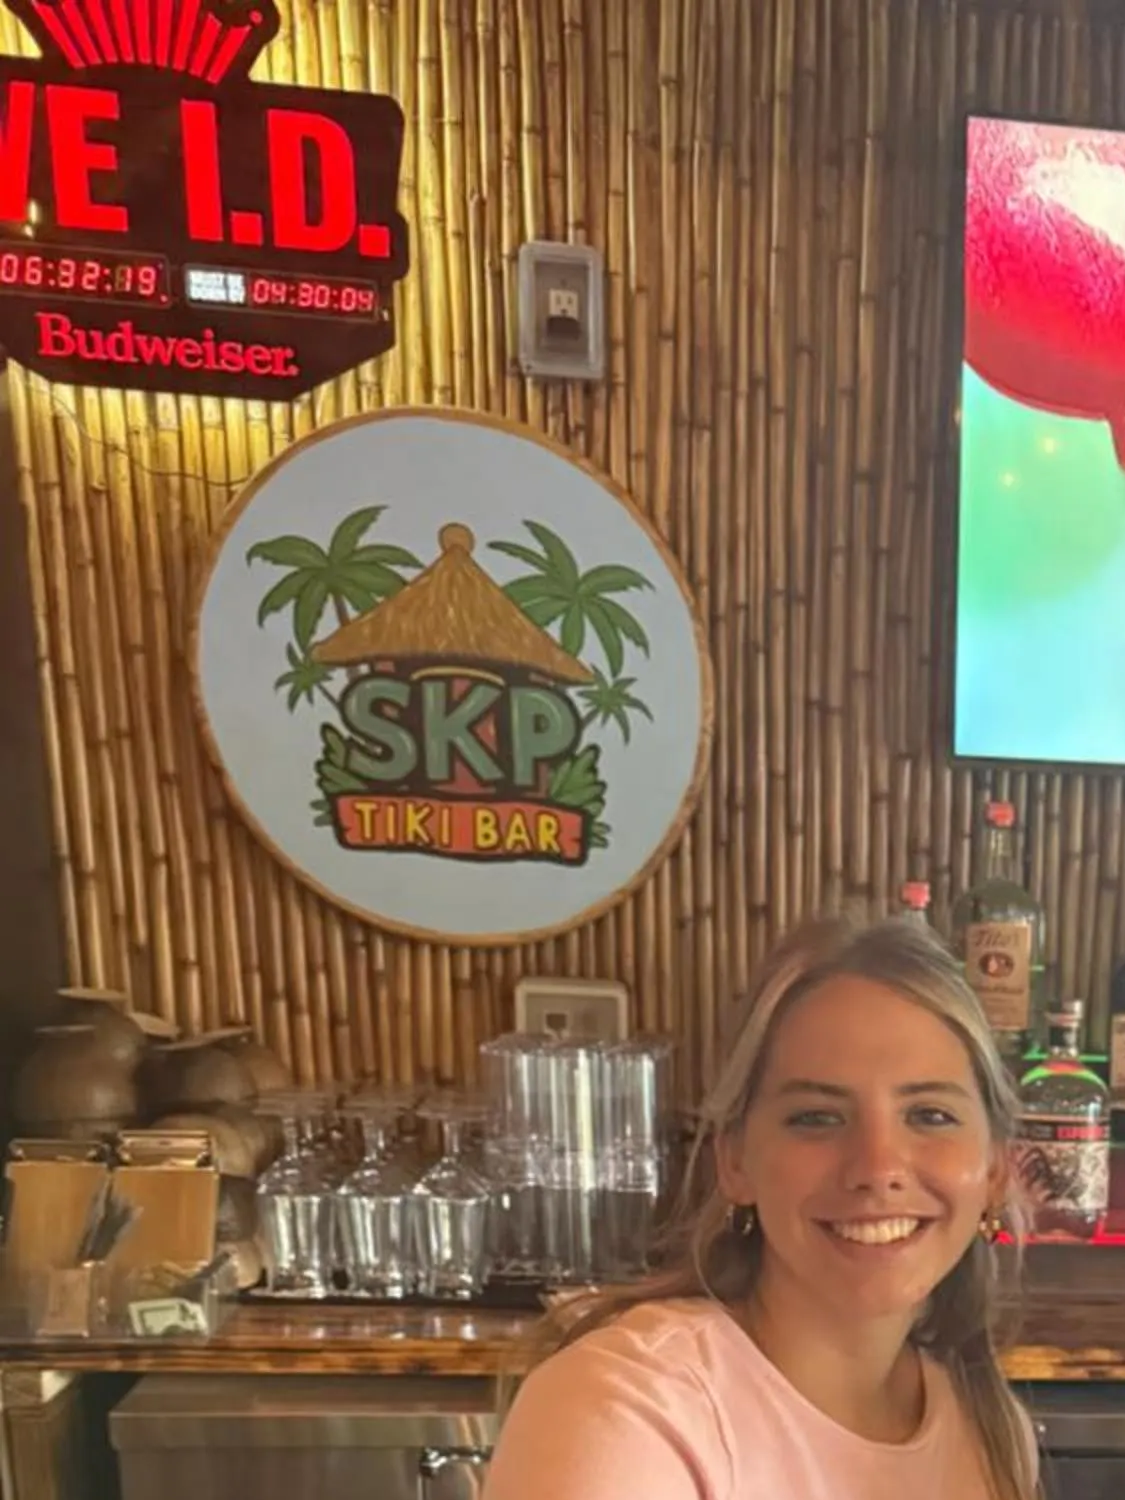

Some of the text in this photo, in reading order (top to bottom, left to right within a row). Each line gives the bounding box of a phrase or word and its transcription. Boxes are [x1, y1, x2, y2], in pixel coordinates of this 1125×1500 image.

[181, 99, 391, 258] I.D.
[1, 253, 156, 295] 06:32:19
[253, 279, 374, 311] 04:30:04
[343, 675, 578, 787] SKP
[354, 803, 561, 851] TIKI BAR
